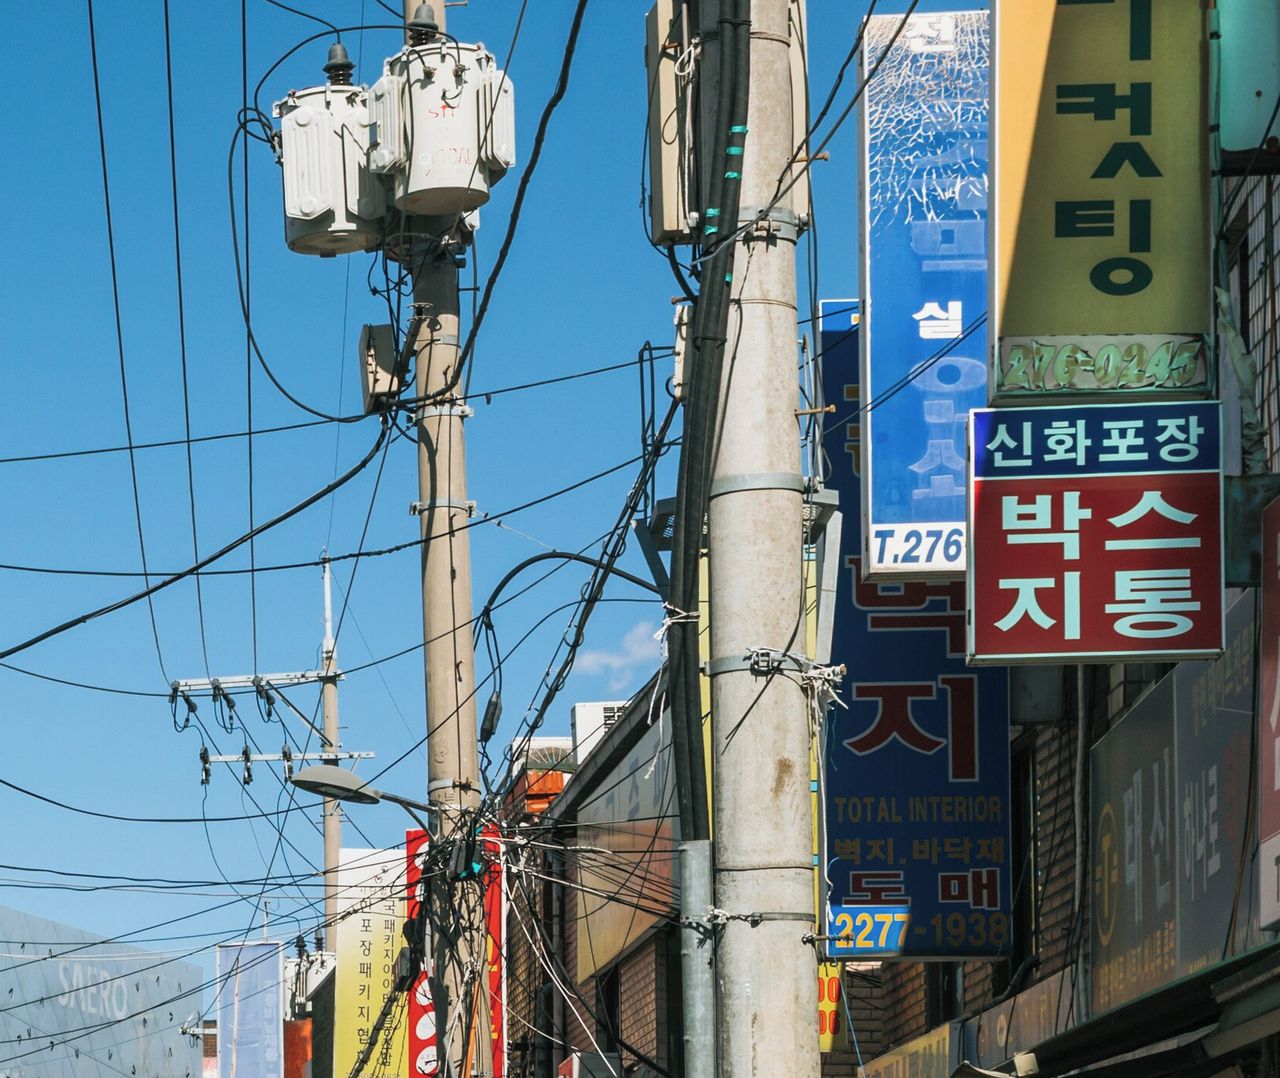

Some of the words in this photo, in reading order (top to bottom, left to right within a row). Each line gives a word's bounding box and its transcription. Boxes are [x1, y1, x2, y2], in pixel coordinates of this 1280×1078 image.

[986, 414, 1205, 468] 신화포장
[1000, 489, 1202, 560] 박스
[993, 568, 1202, 640] 지통
[835, 797, 902, 824] TOTAL
[908, 794, 1004, 823] INTERIOR
[834, 911, 1007, 949] 2277-1938
